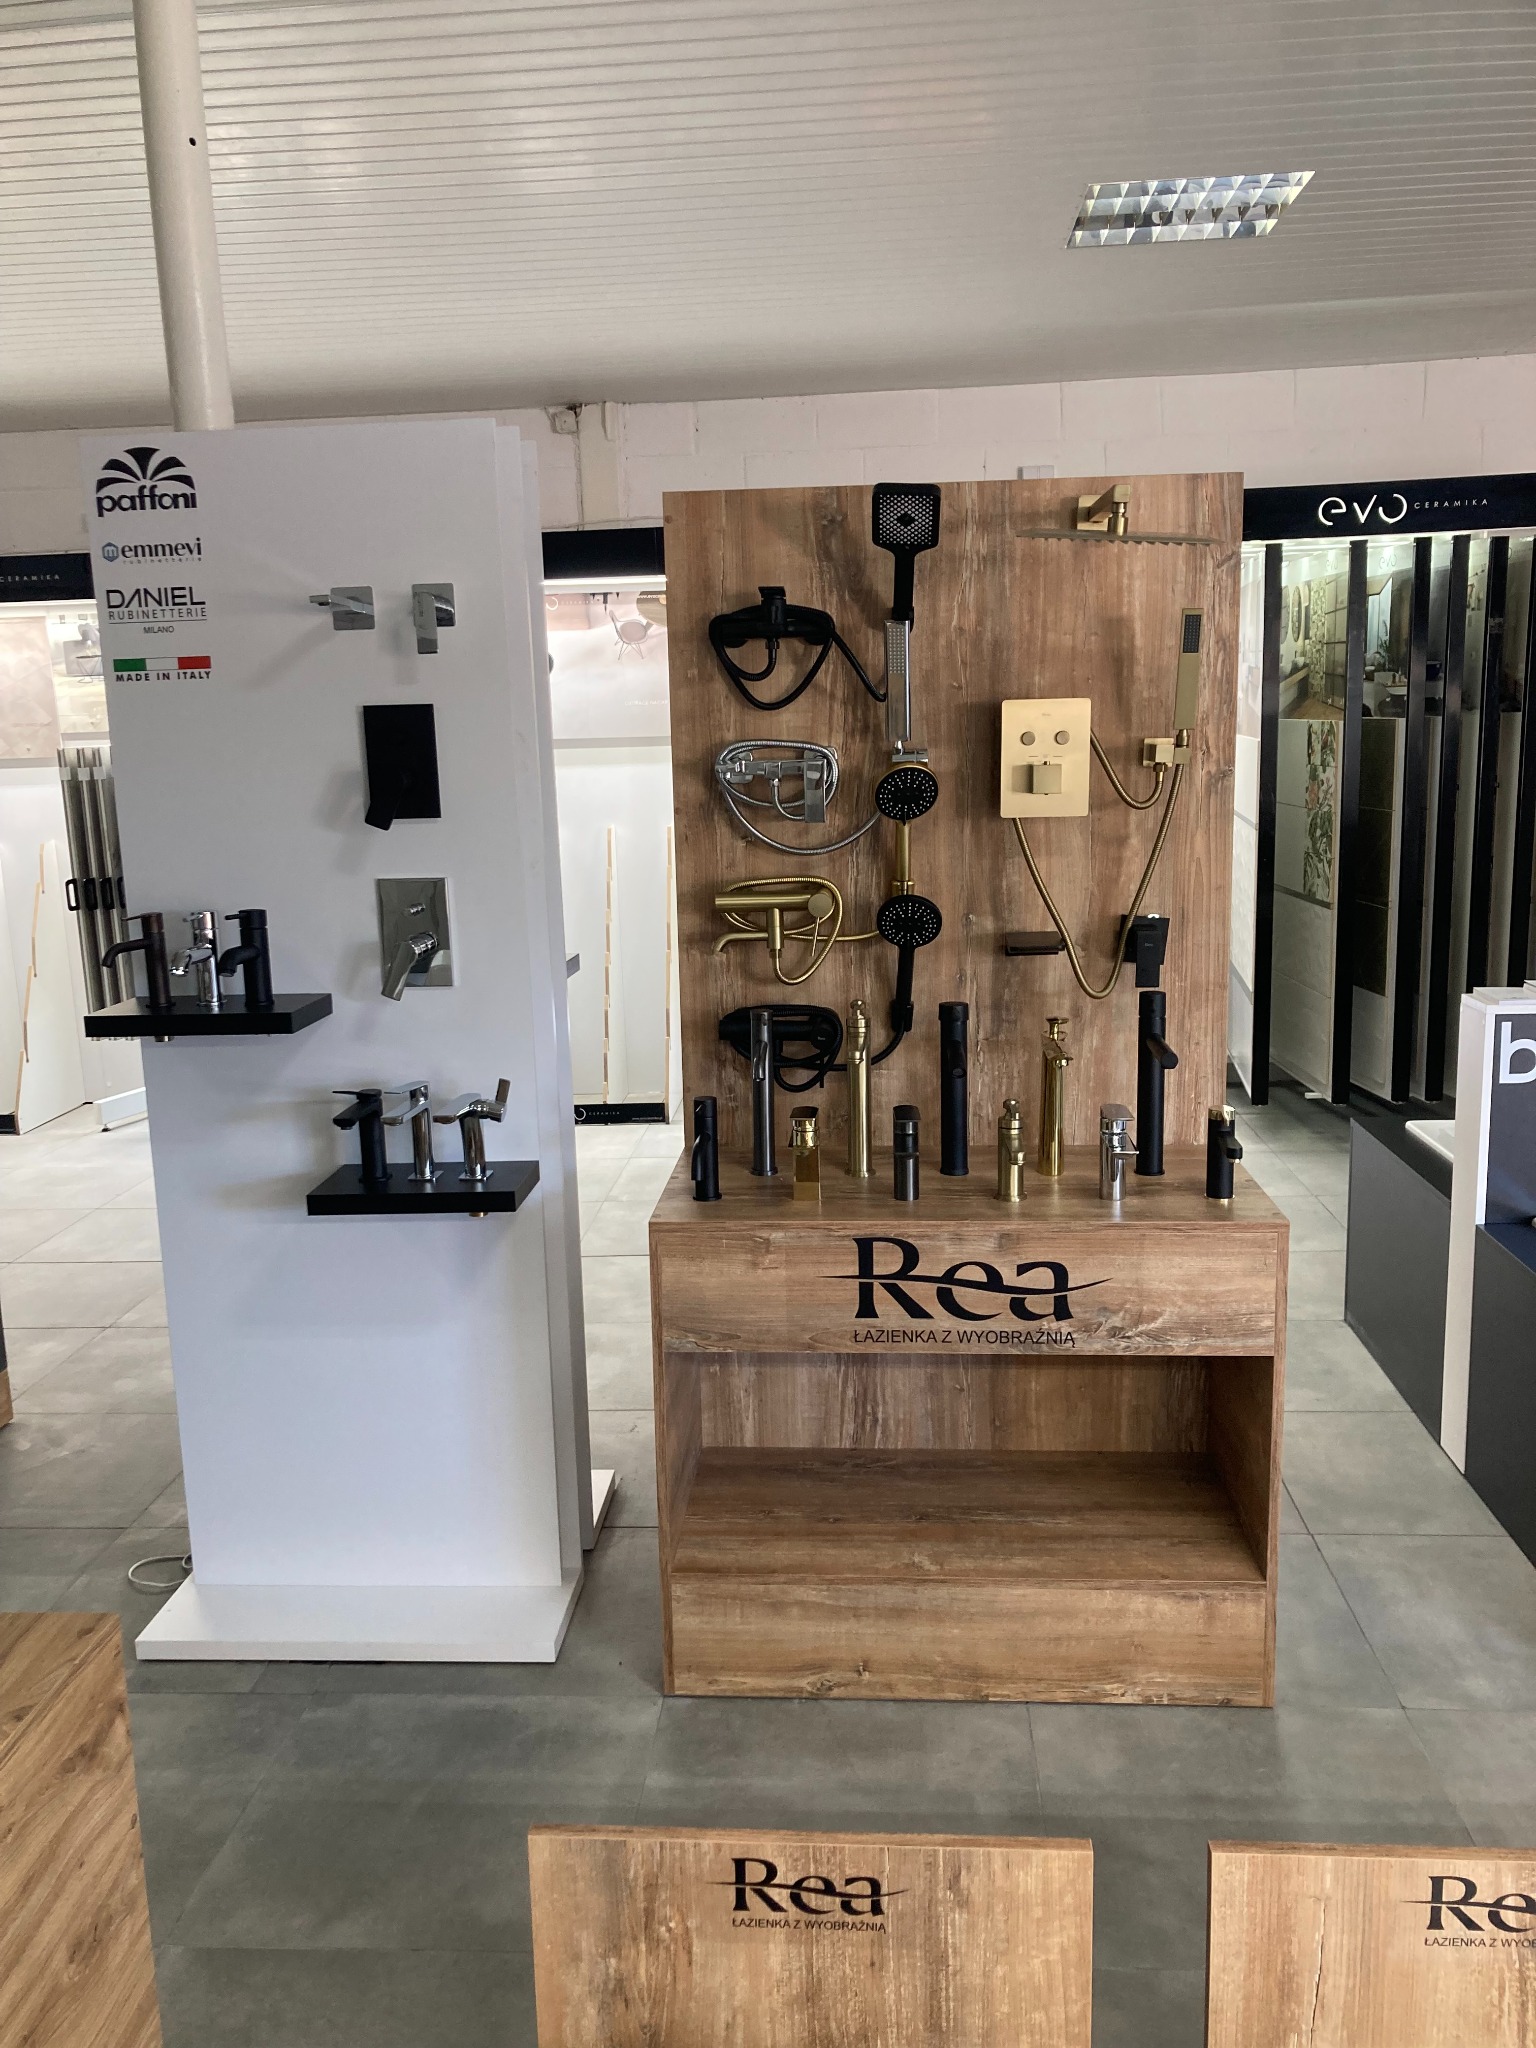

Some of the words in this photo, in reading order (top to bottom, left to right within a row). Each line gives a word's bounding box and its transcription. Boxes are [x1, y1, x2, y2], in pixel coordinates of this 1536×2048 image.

[96, 485, 198, 518] paffoni
[1318, 493, 1408, 526] evo
[1414, 498, 1488, 509] CERAMIKA
[121, 537, 202, 559] emmevi
[106, 586, 206, 609] DANIEL
[109, 607, 207, 620] RUBINETTERIE
[143, 625, 175, 634] MILANO
[116, 673, 150, 682] MADE
[157, 672, 170, 681] IN
[177, 671, 211, 680] ITALY
[852, 1236, 1074, 1322] Rea
[853, 1329, 938, 1344] ŁAZIENKA
[941, 1330, 952, 1344] Z
[957, 1328, 1076, 1349] WYOBRAŹNIĄ
[731, 1857, 885, 1917] Rea
[1426, 1875, 1536, 1933] Re
[732, 1917, 791, 1930] ŁAZIENKA
[793, 1919, 801, 1930] Z
[804, 1919, 887, 1935] WYOBRAŹNIĄ
[1424, 1936, 1487, 1948] ŁAZIENKA
[1489, 1938, 1498, 1948] Z
